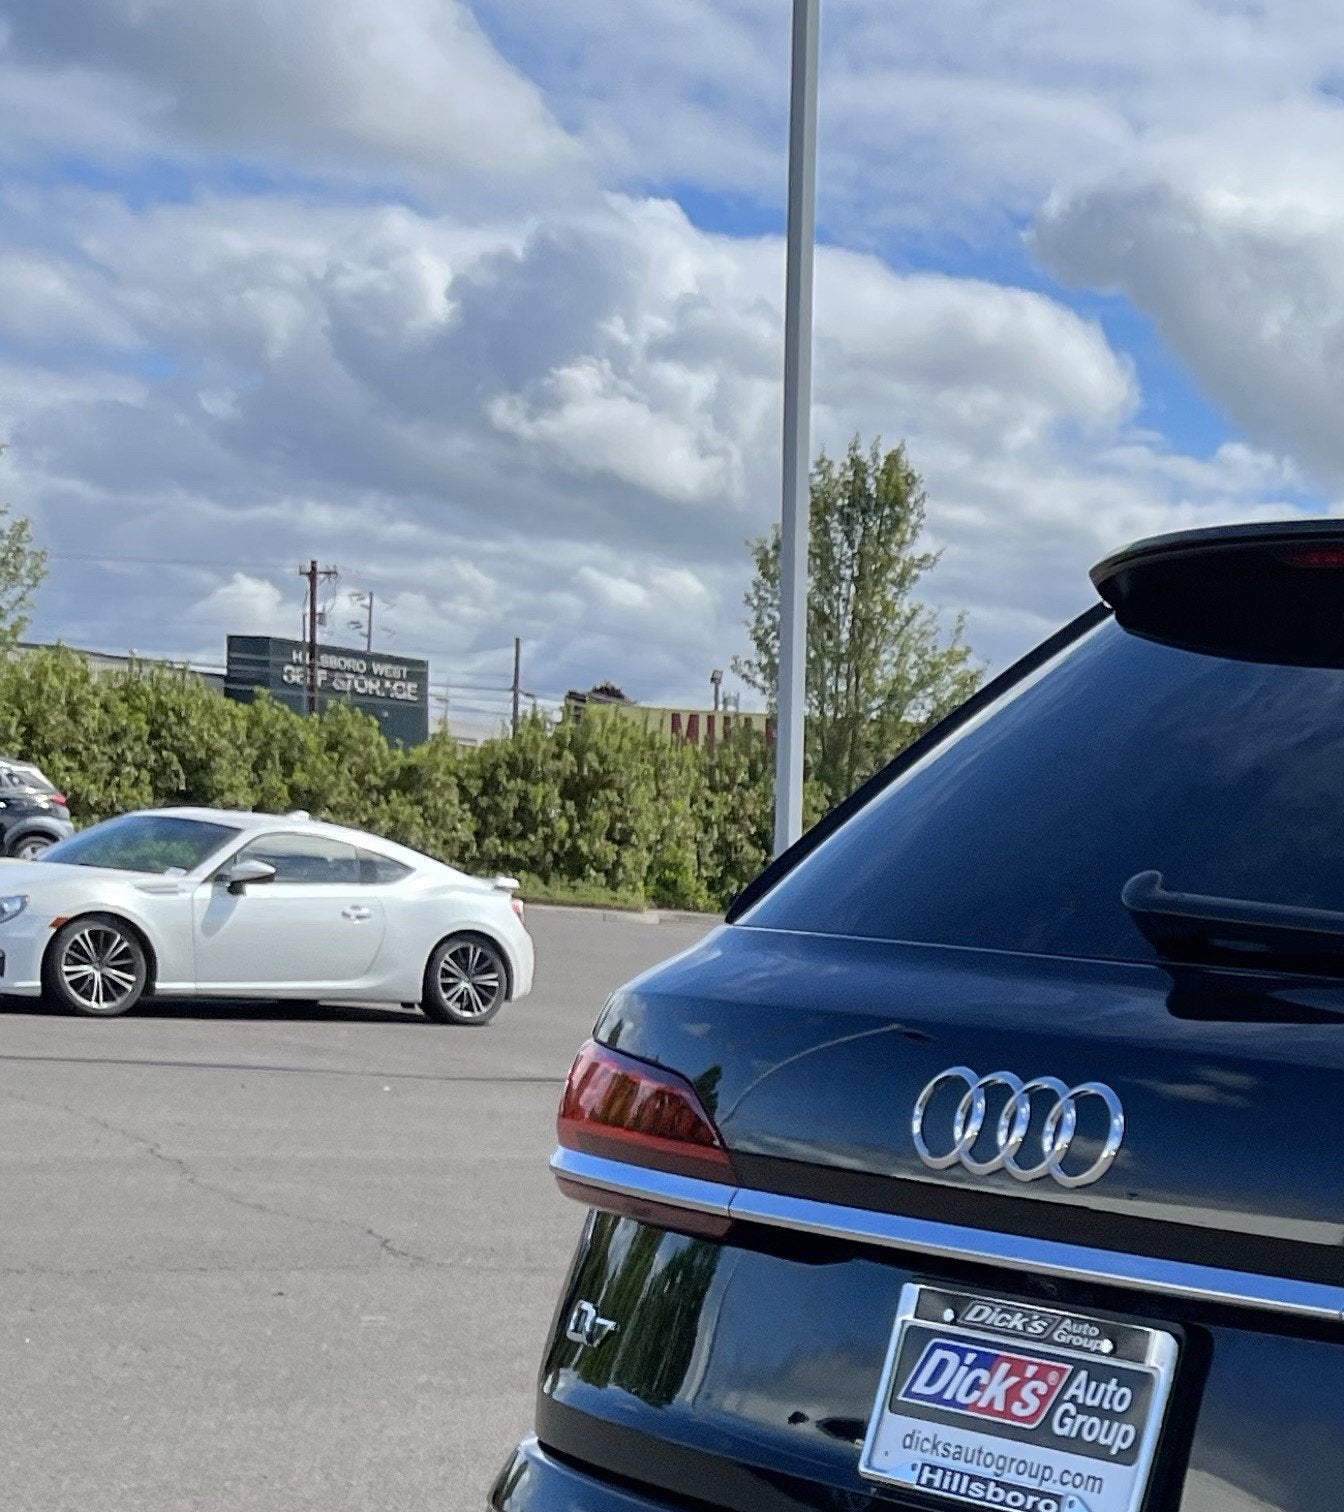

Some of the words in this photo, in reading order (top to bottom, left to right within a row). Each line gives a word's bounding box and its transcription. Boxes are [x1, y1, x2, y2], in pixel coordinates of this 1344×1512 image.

[292, 650, 367, 674] HISBORO
[566, 1299, 617, 1348] Q7
[964, 1303, 1049, 1335] Dick's
[1060, 1318, 1100, 1337] Auto
[1052, 1329, 1104, 1352] Group
[911, 1348, 1050, 1418] Dick's
[1063, 1369, 1133, 1414] Auto
[1052, 1402, 1137, 1456] Group
[901, 1428, 1105, 1495] dicksautogroup.com
